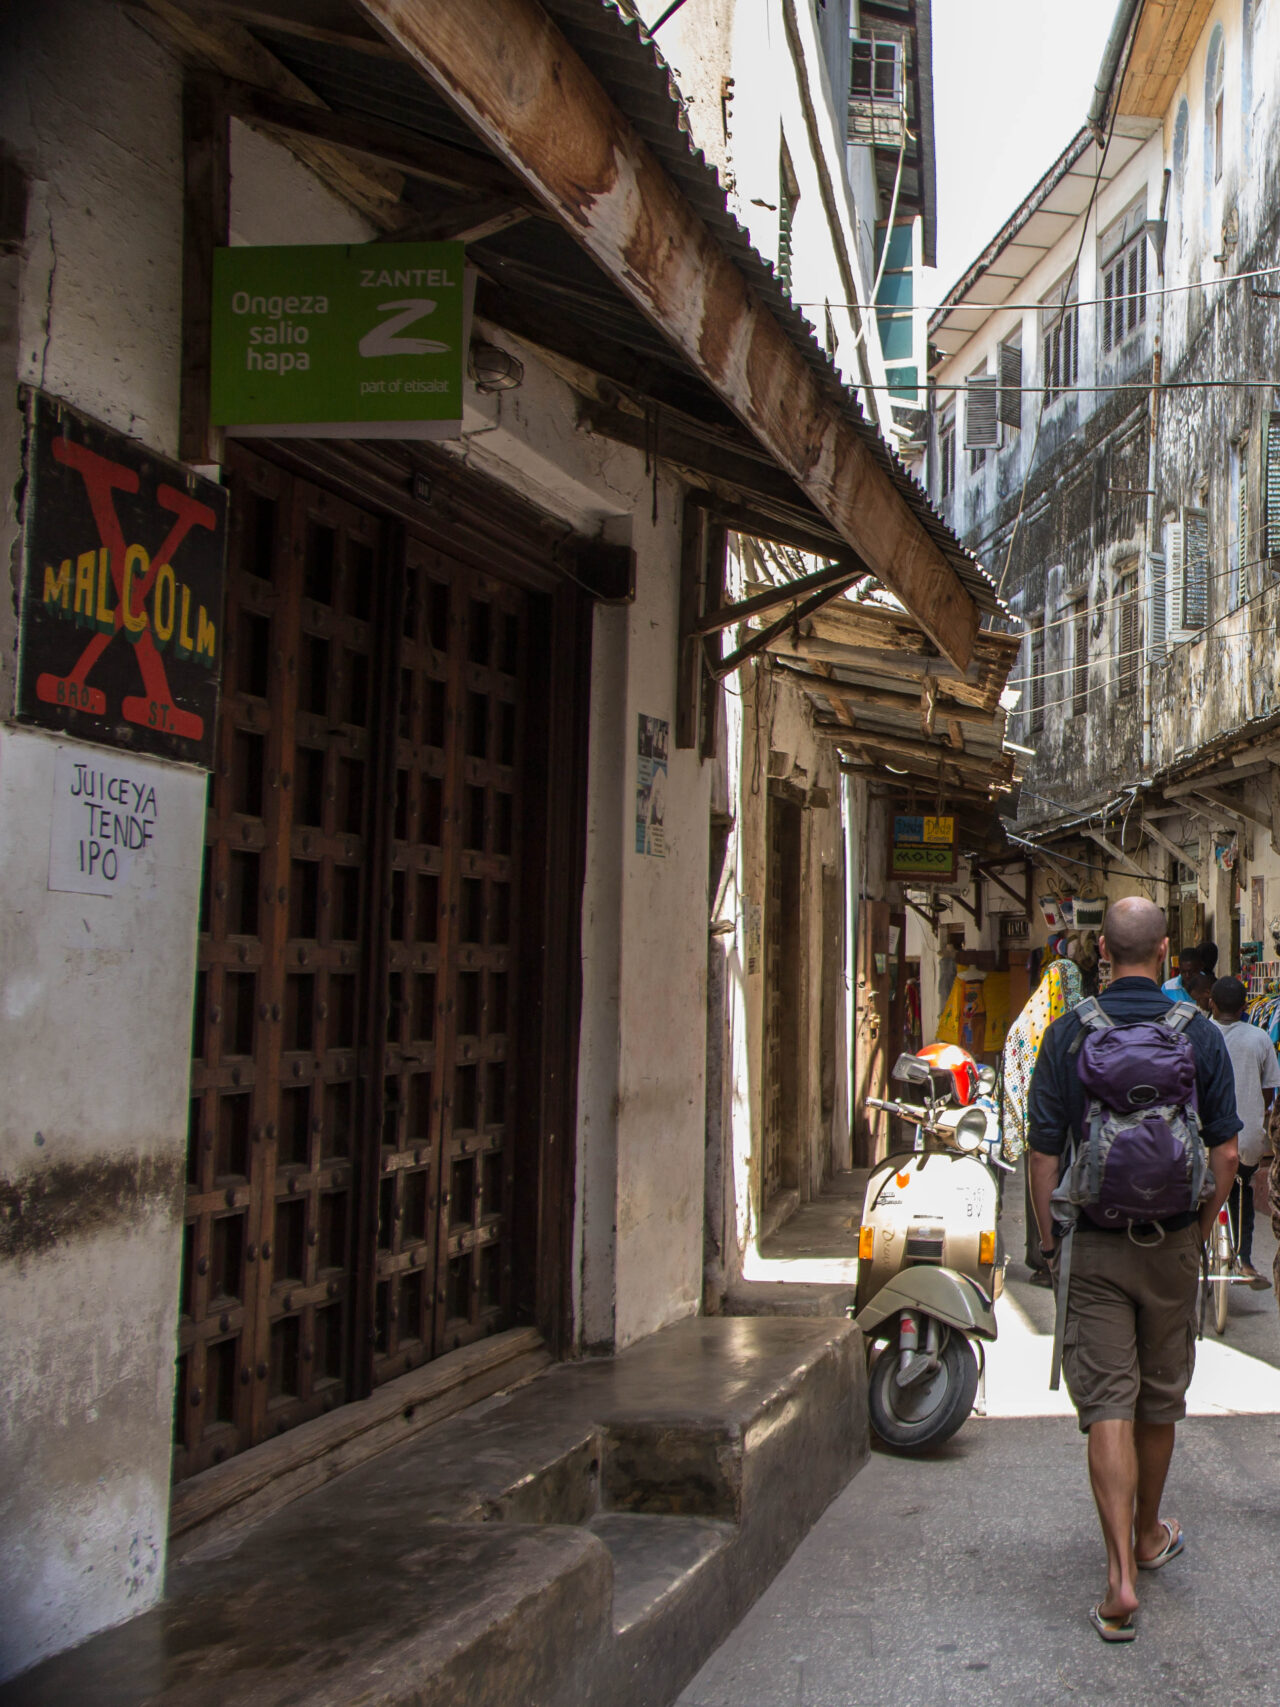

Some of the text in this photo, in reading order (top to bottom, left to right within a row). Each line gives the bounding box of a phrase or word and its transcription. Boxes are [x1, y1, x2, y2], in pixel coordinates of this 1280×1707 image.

[360, 269, 457, 288] ZANTEL
[231, 291, 329, 319] Ongeza
[249, 321, 310, 345] salio
[246, 347, 310, 375] hapa
[360, 379, 450, 396] part of etisalat
[43, 543, 217, 660] MALCOLM
[149, 701, 175, 731] ST.
[80, 840, 118, 880] IPO
[896, 851, 946, 863] moto
